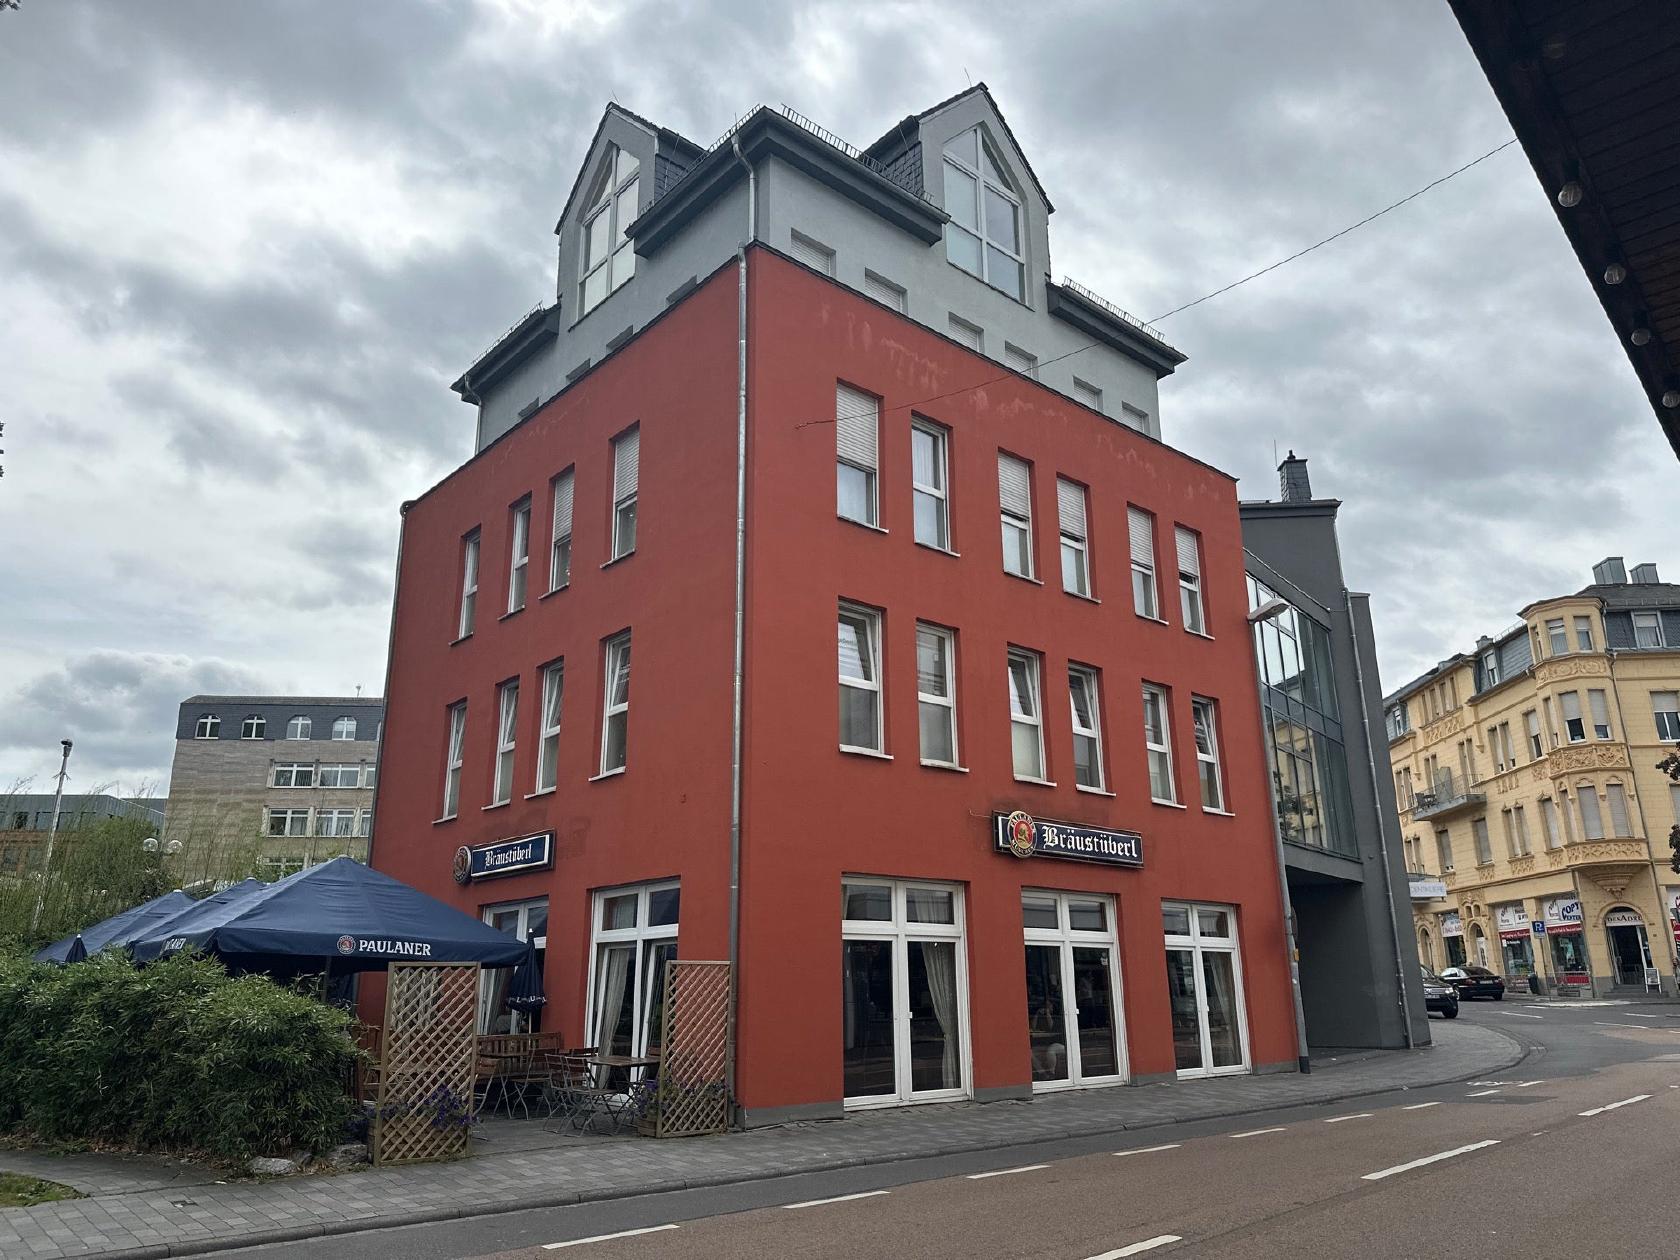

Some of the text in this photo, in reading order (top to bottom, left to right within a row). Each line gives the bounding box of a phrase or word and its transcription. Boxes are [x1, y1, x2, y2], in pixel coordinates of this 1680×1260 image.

[1041, 825, 1138, 857] Bräustüberl
[485, 843, 532, 869] Bräustüberl
[358, 939, 431, 956] PAULANER
